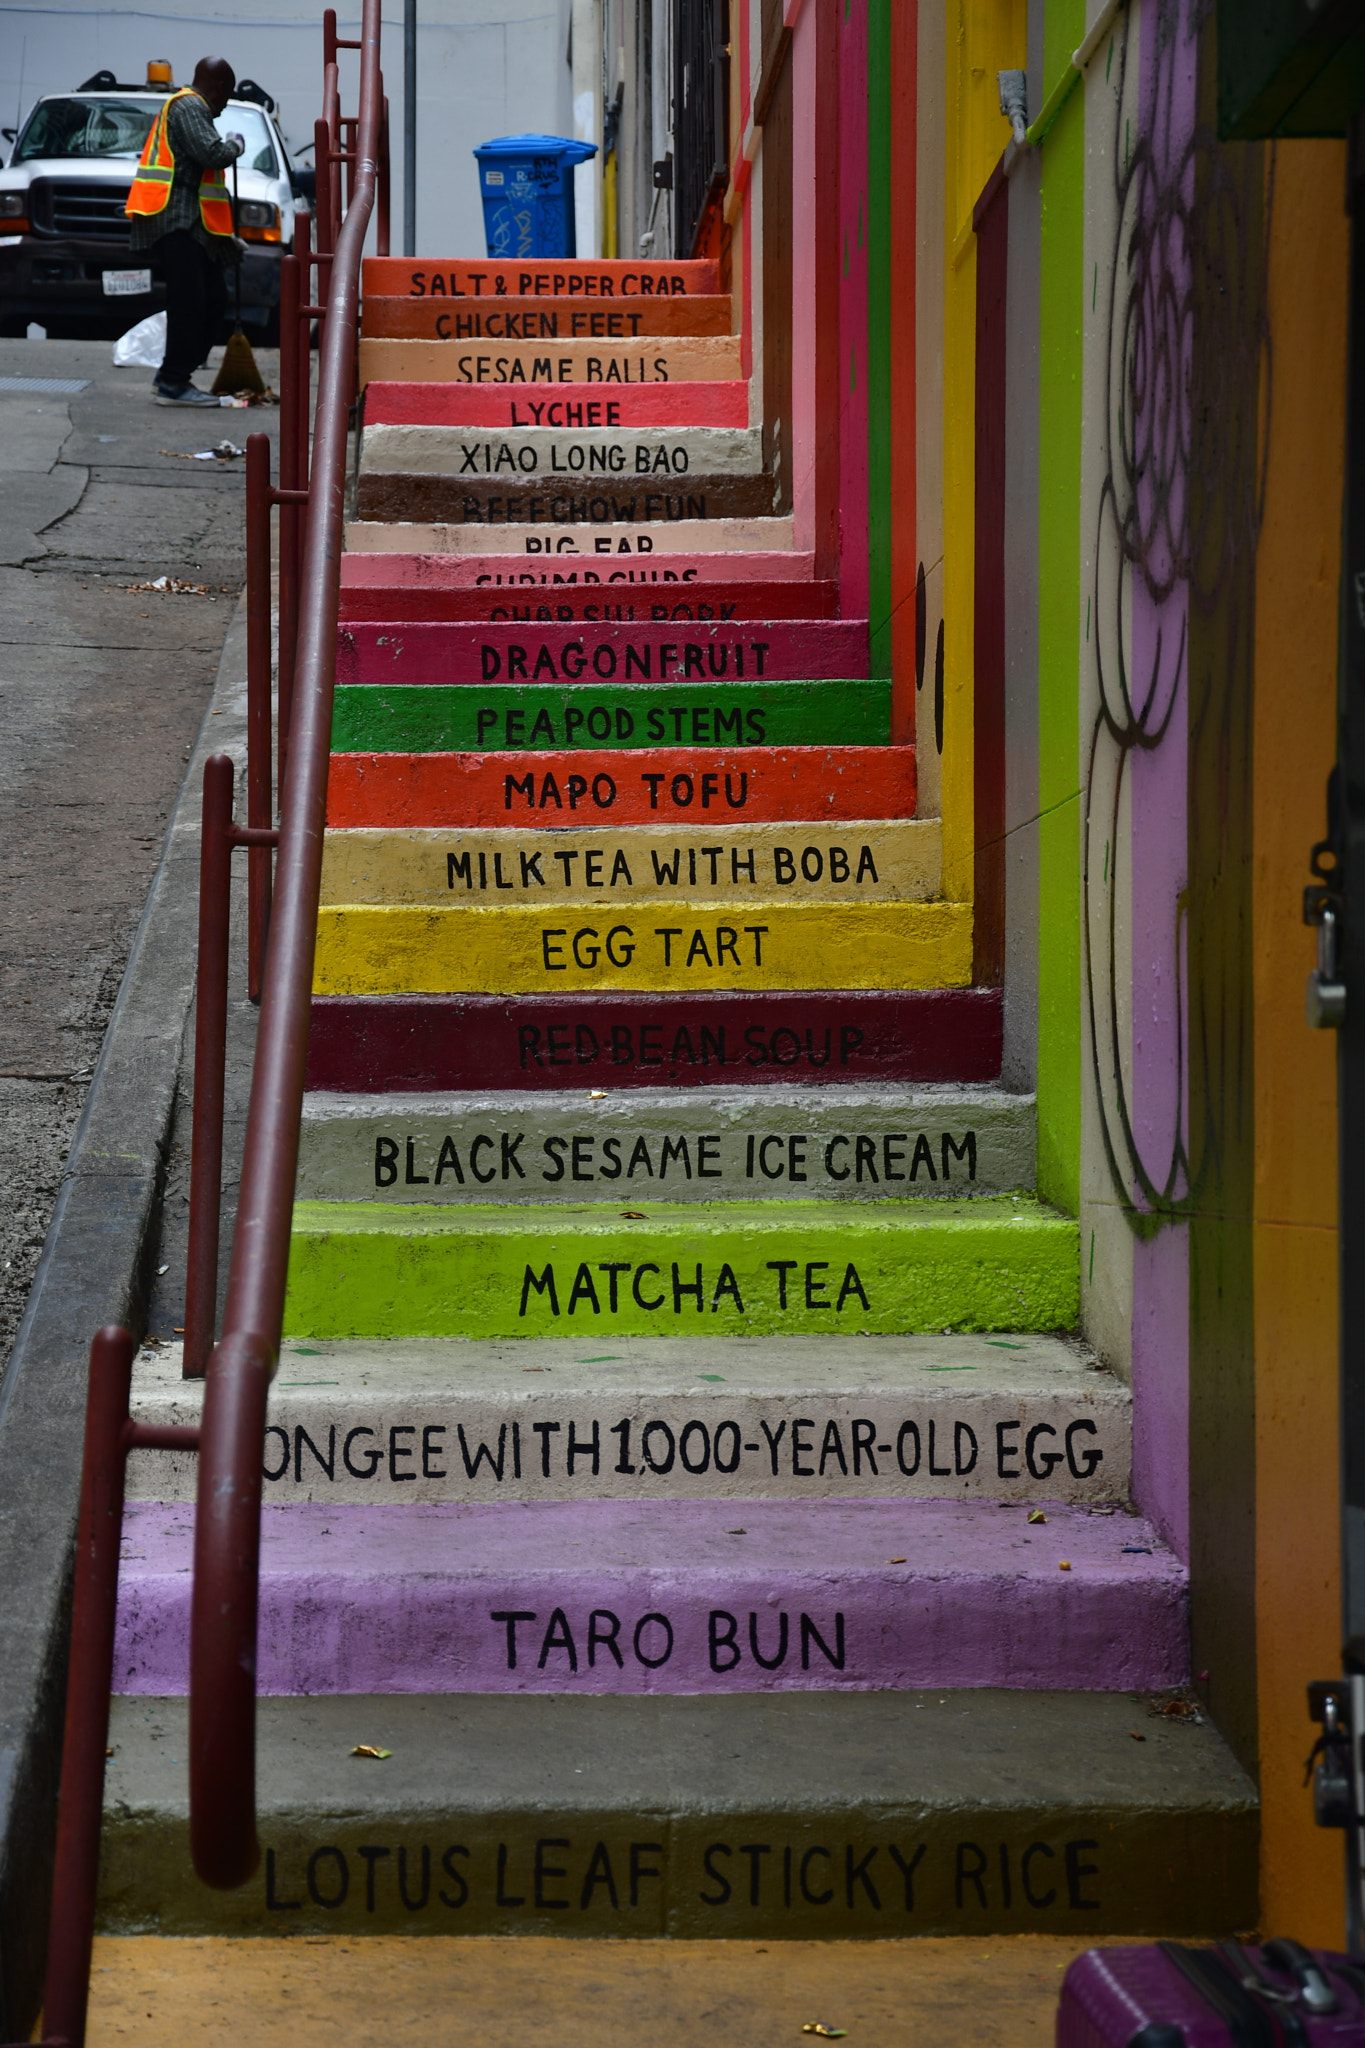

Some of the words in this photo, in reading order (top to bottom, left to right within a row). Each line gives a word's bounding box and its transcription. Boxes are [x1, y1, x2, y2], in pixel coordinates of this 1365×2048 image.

[410, 273, 487, 296] SALT
[494, 275, 507, 295] &
[519, 274, 614, 296] PEPPER
[621, 273, 686, 295] CRAB
[436, 313, 557, 338] CHICKEN
[572, 313, 642, 337] FEET
[457, 357, 572, 383] SESAME
[587, 357, 668, 382] BALLS
[511, 402, 620, 426] LYCHEE
[459, 443, 538, 473] XIAO
[551, 444, 626, 472] LONG
[635, 444, 688, 473] BAO
[645, 494, 706, 520] FUN
[646, 707, 766, 745] STEMS
[504, 772, 616, 809] MAPO
[641, 772, 748, 808] TOFU
[446, 851, 546, 889] MILK
[554, 849, 632, 887] TEA
[651, 847, 756, 885] WITH
[774, 846, 878, 884] BOBA
[542, 926, 635, 970] EGG
[655, 926, 768, 968] TART
[519, 1024, 598, 1068] RED
[611, 1025, 726, 1066] BEAN
[743, 1025, 864, 1066] SOUP
[375, 1132, 524, 1187] BLACK
[541, 1134, 720, 1181] SESAME
[745, 1133, 807, 1181] ICE
[823, 1131, 978, 1181] CREAM
[518, 1262, 744, 1317] MATCHA
[767, 1261, 870, 1311] TEA
[262, 1424, 446, 1482] ONGEE
[458, 1418, 600, 1482] WITH
[999, 1417, 1103, 1479] EGG
[491, 1608, 674, 1671] TARO
[708, 1611, 846, 1670] BUN
[265, 1845, 469, 1911] LOTUS
[496, 1838, 664, 1908] LEAF
[700, 1843, 927, 1912] STICKY
[955, 1838, 1101, 1910] RICE
